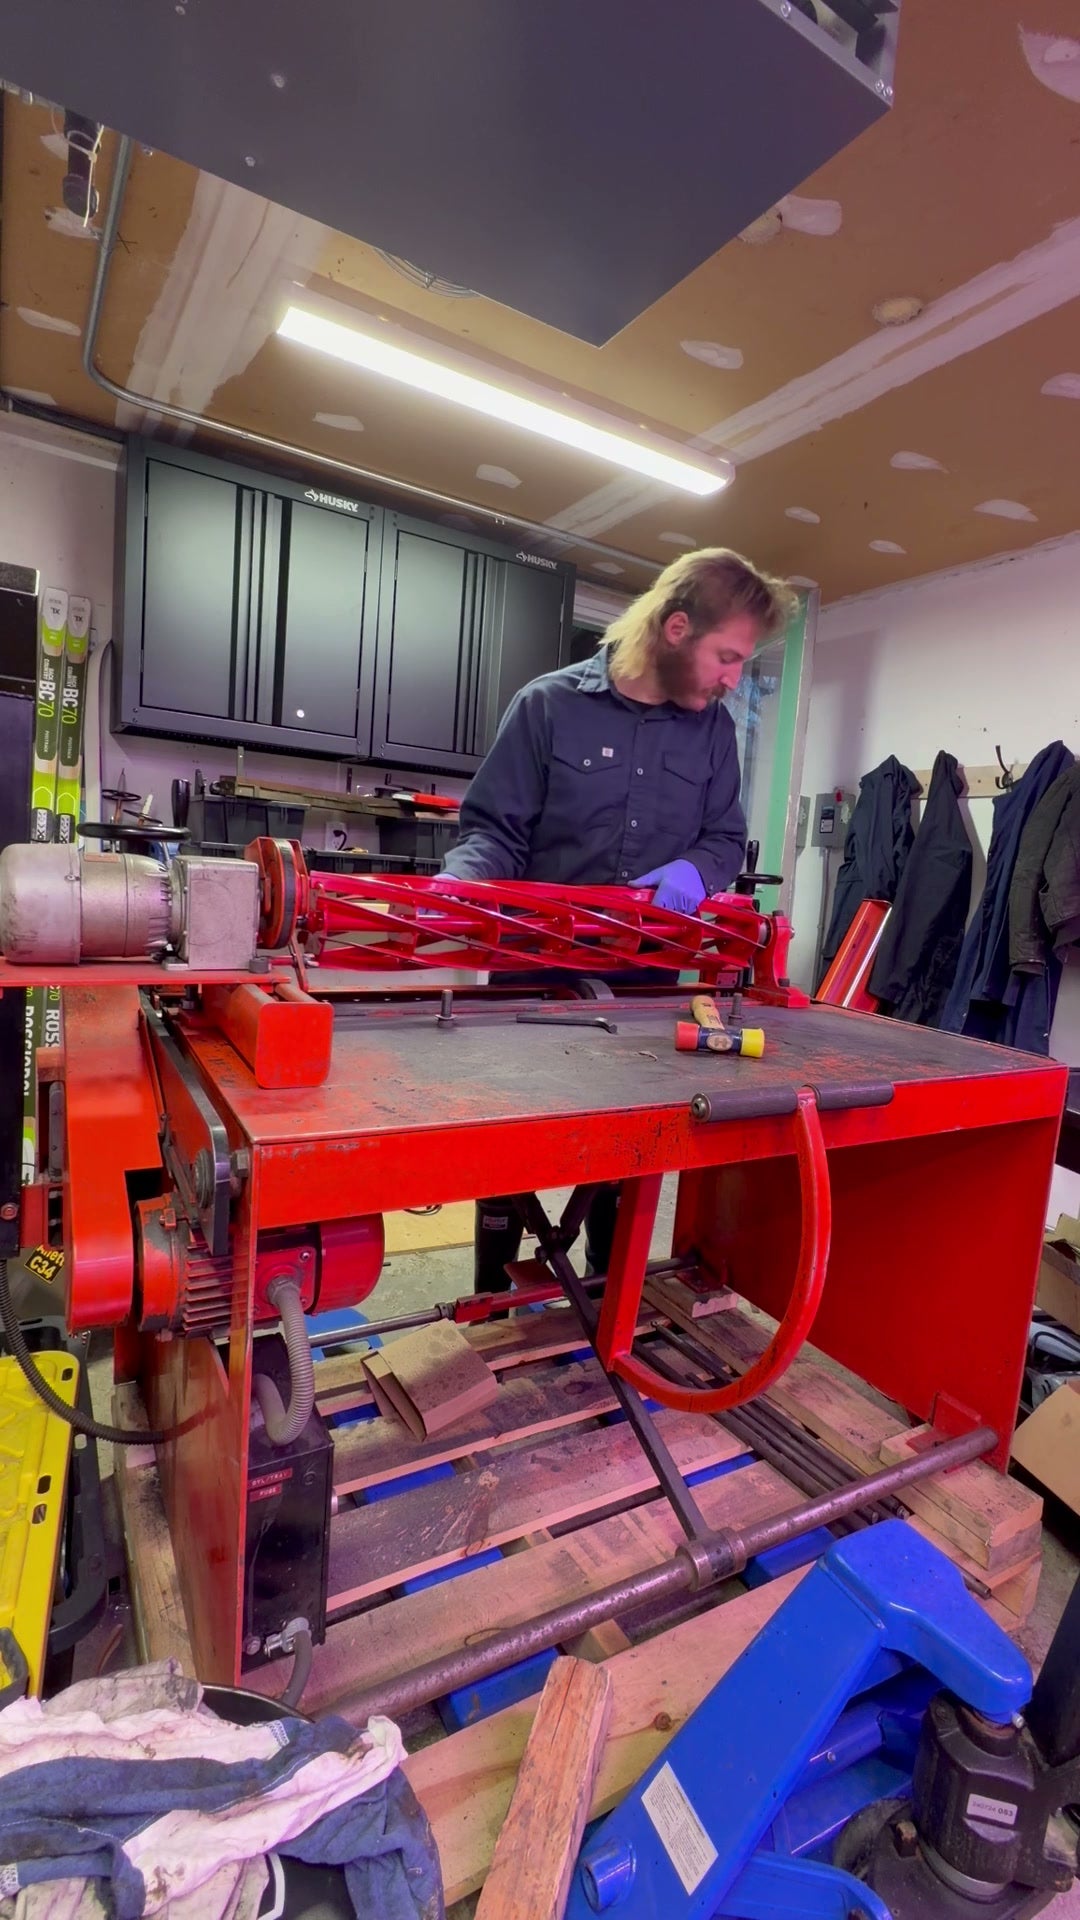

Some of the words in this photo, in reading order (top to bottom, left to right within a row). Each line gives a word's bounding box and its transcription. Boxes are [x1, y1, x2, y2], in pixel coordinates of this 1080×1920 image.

[319, 492, 359, 512] HUSKY
[527, 554, 557, 570] HUSKY
[29, 1255, 57, 1279] C34
